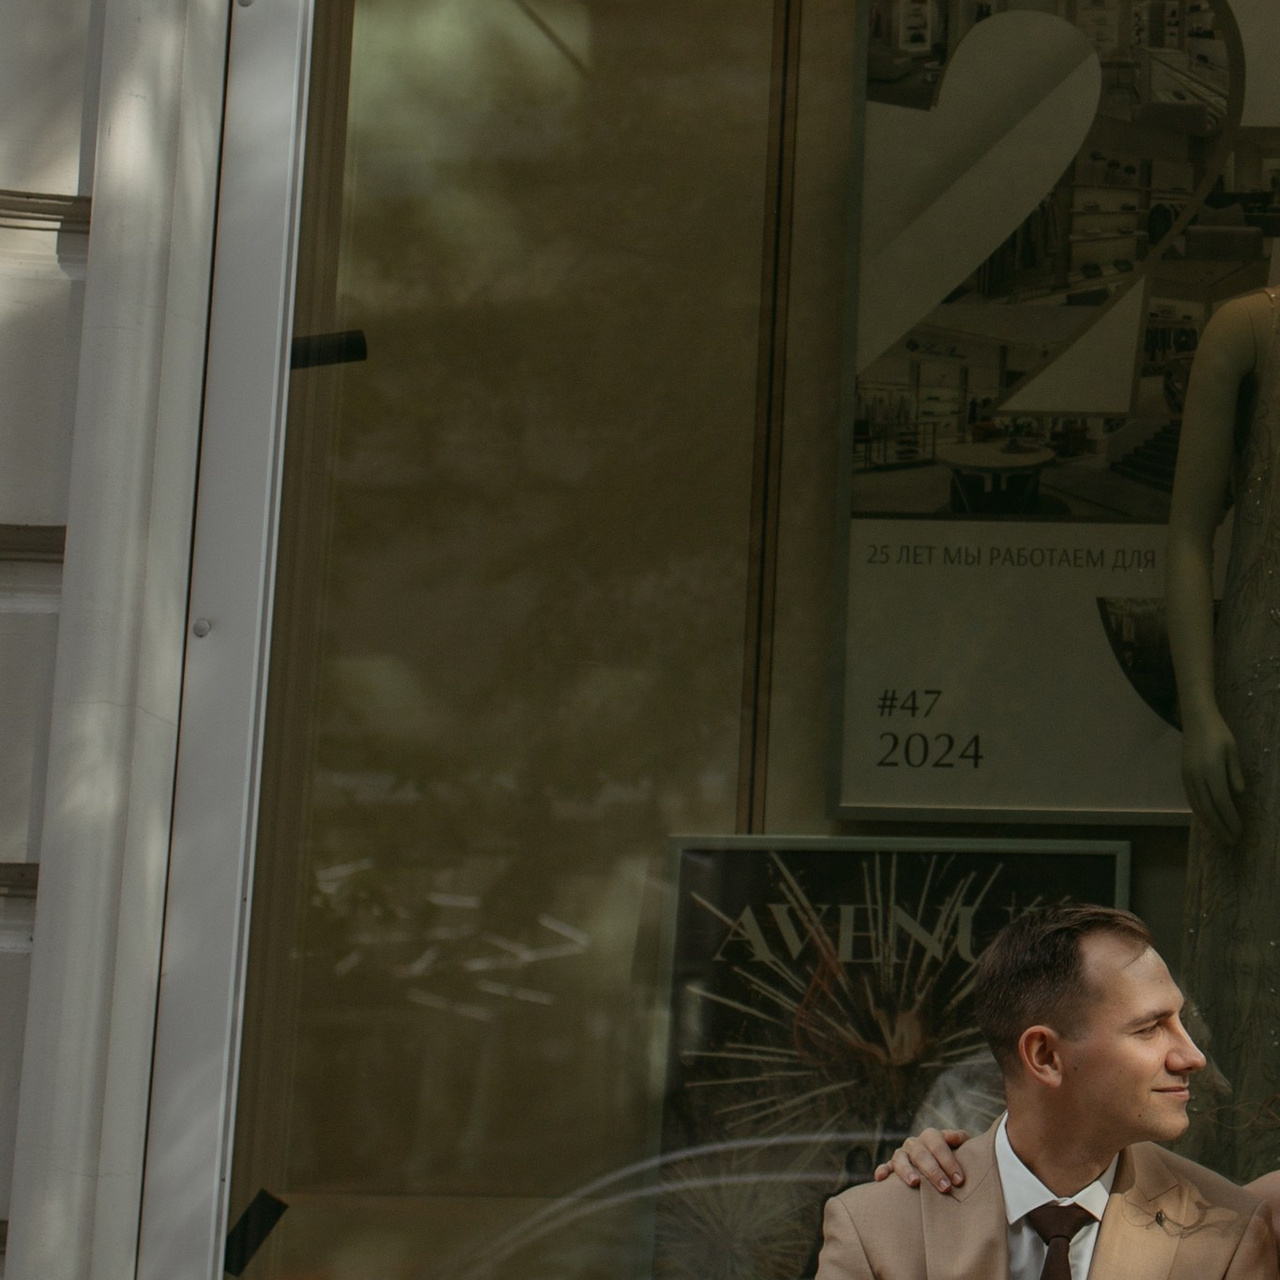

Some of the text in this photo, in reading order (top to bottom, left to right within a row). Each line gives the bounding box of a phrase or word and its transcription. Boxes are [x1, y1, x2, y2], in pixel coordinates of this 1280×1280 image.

[866, 545, 1156, 572] 25 ЛЕТ МЫ РАБОТАЕМ ДЛЯ
[877, 688, 942, 718] #47
[876, 732, 984, 768] 2024
